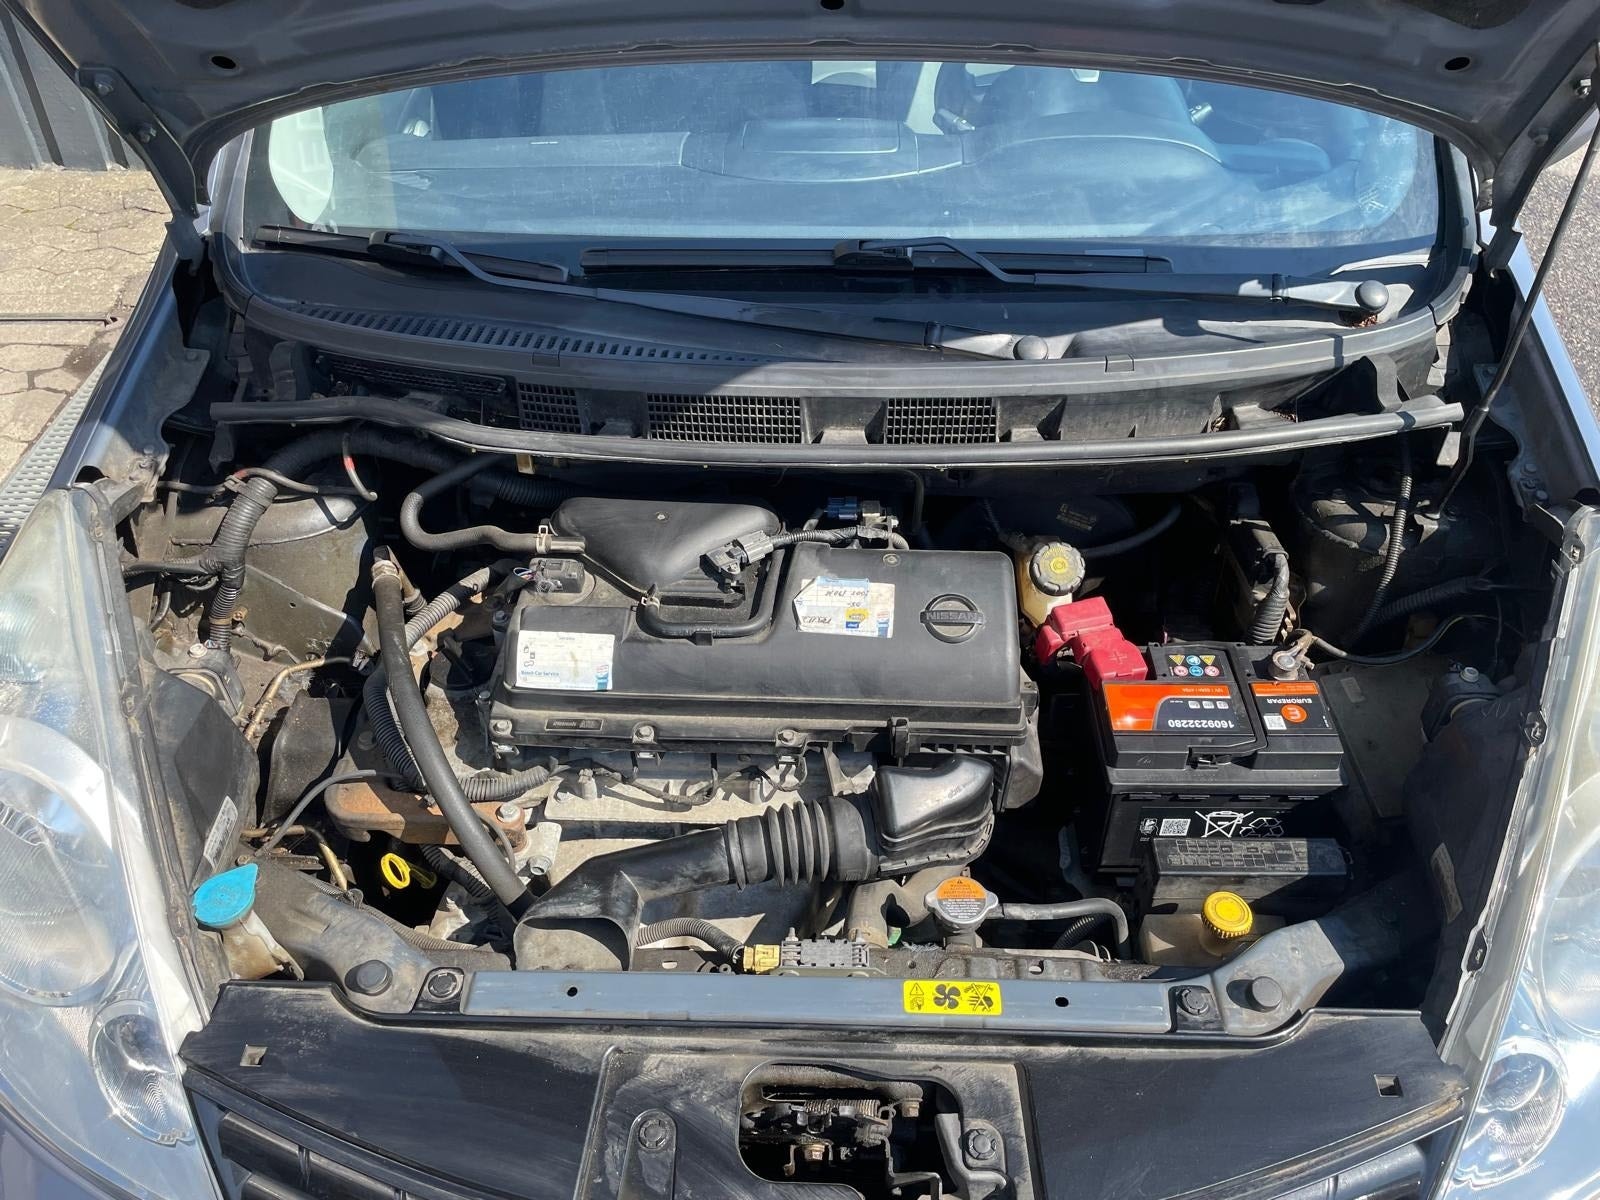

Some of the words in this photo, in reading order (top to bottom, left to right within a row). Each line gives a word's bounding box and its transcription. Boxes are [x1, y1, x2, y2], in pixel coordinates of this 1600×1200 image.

[926, 611, 977, 621] NISSAN
[1266, 697, 1313, 705] EUROREPAR
[1167, 718, 1235, 730] 1609232280
